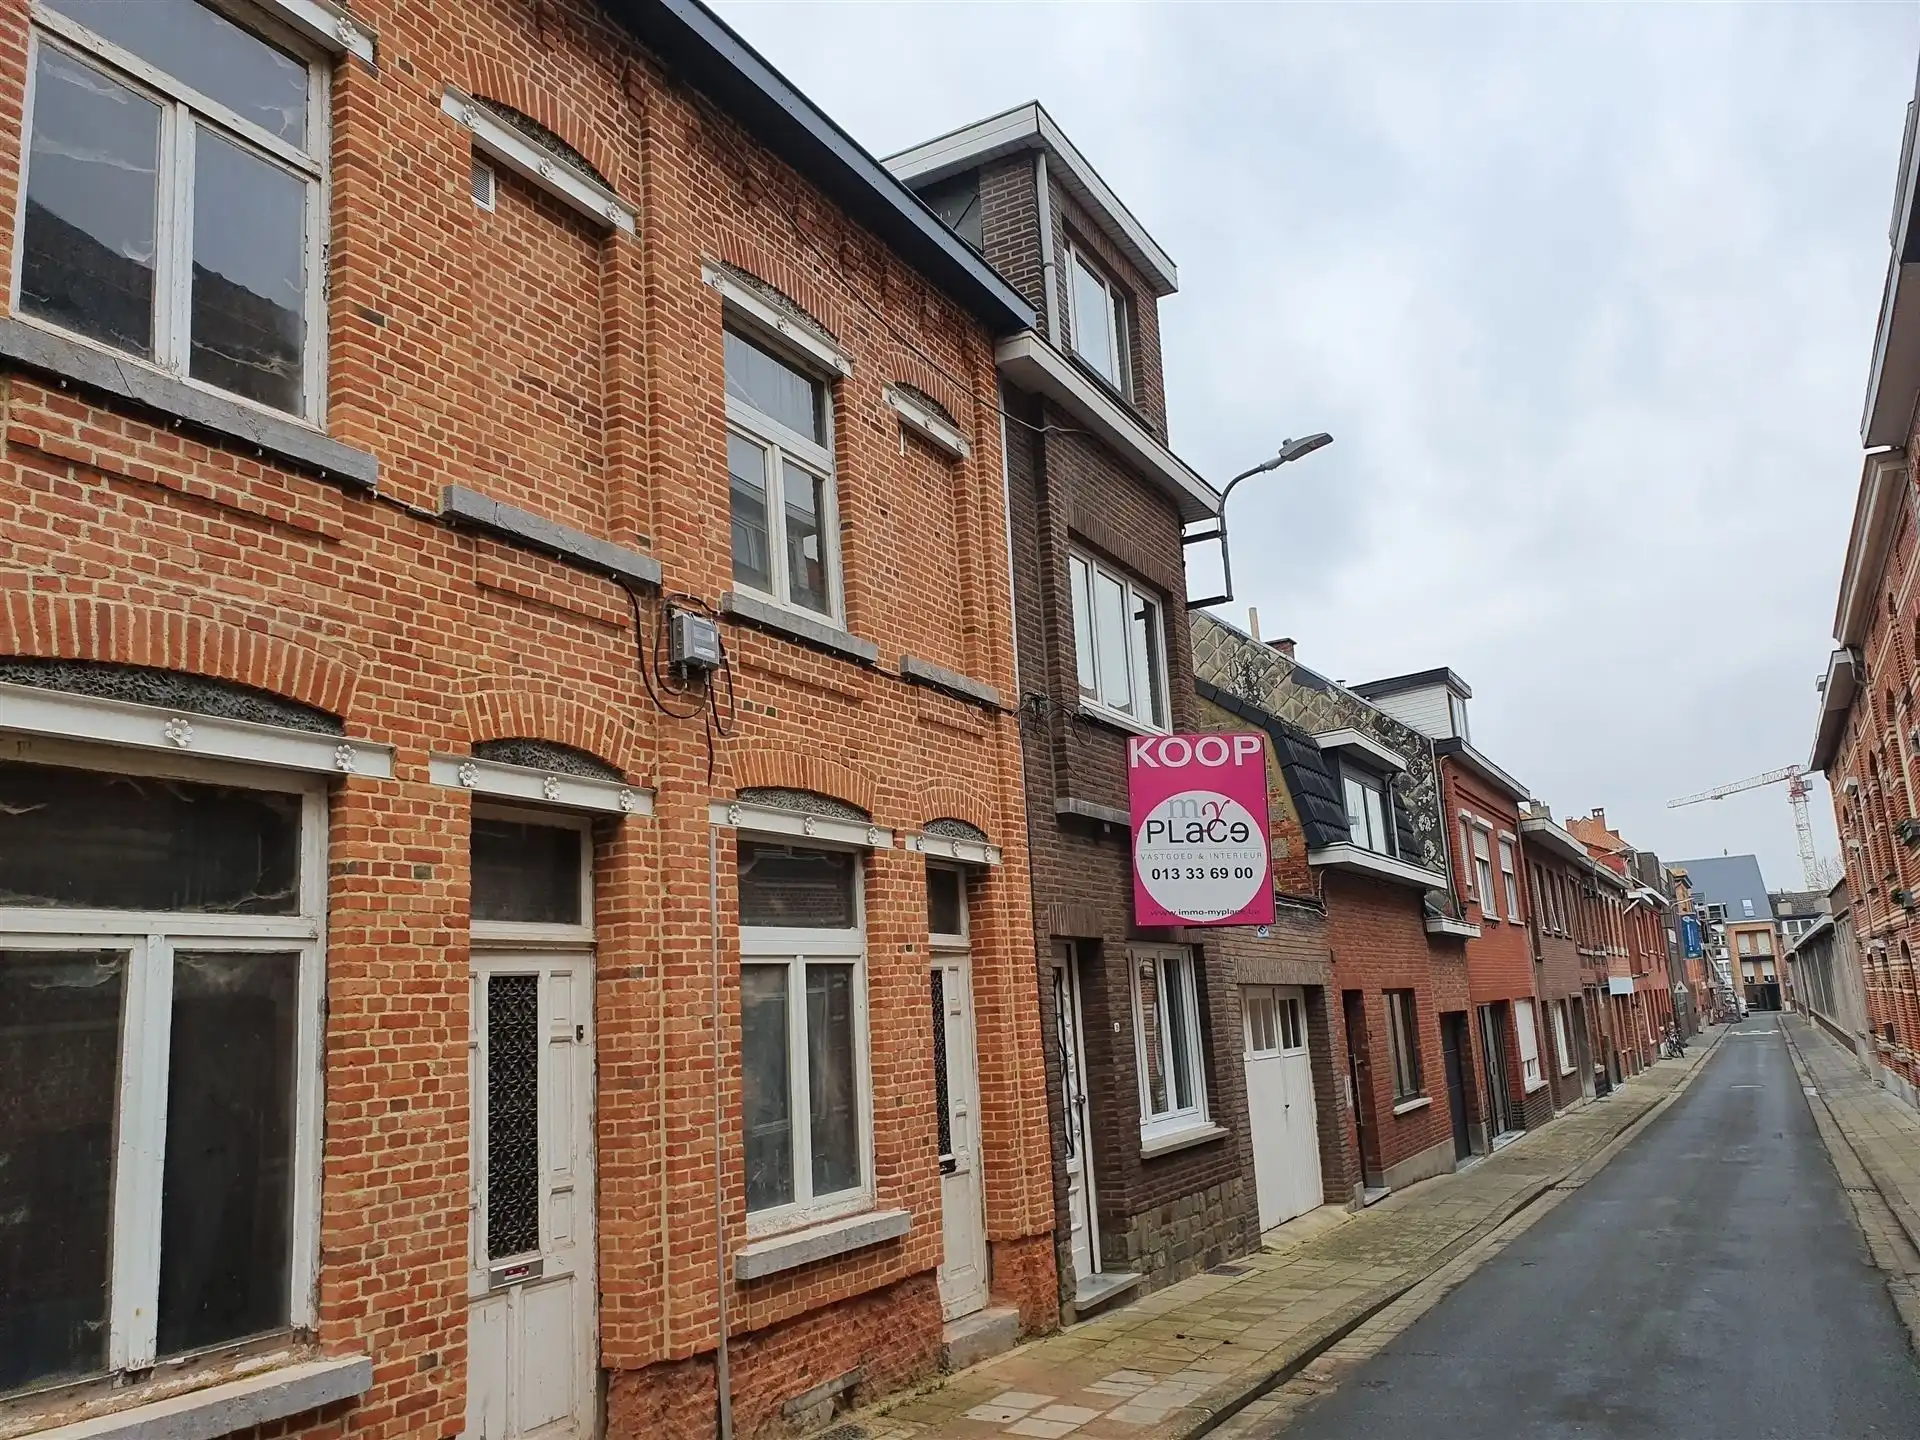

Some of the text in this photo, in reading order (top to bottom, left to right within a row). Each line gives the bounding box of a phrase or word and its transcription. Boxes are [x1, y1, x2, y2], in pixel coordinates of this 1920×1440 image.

[1129, 736, 1261, 768] KOOP
[1167, 798, 1230, 832] my
[1141, 852, 1262, 861] VASTGOED & INTERIEUR
[1151, 867, 1254, 880] 013 33 69 00
